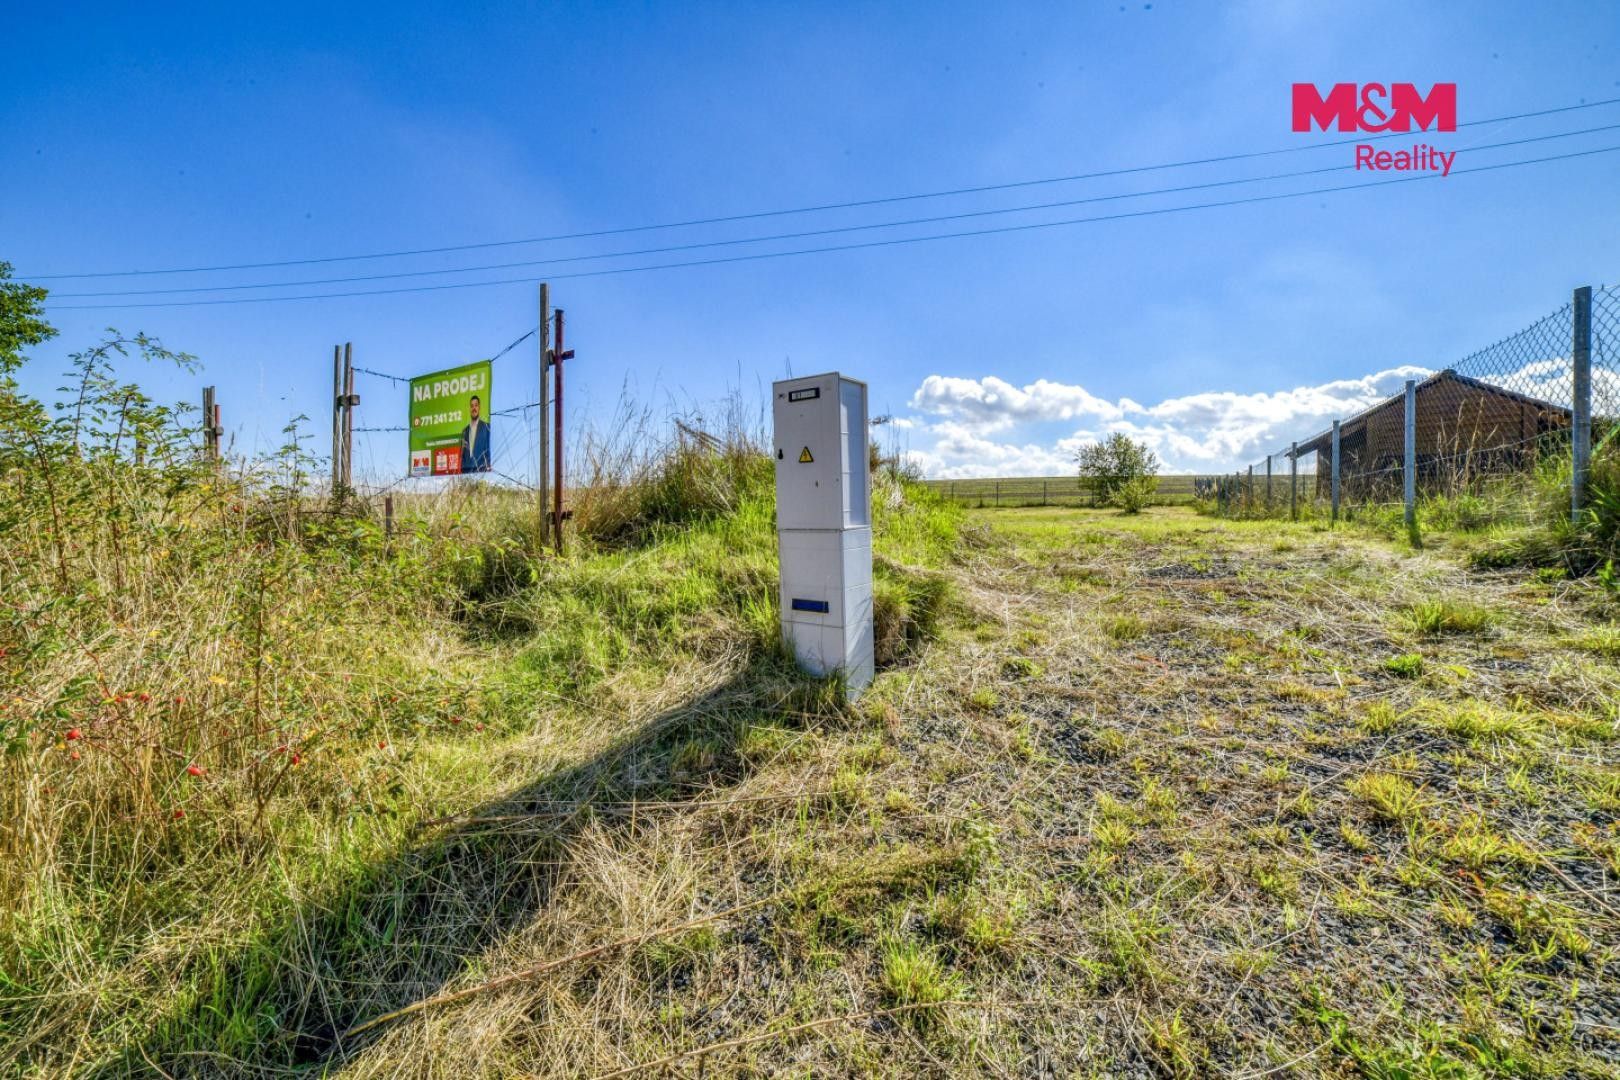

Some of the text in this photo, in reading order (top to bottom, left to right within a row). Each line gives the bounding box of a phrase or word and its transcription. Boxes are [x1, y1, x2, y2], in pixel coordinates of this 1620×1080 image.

[414, 373, 486, 402] NA PRODEJ
[421, 410, 463, 427] 771 241 212
